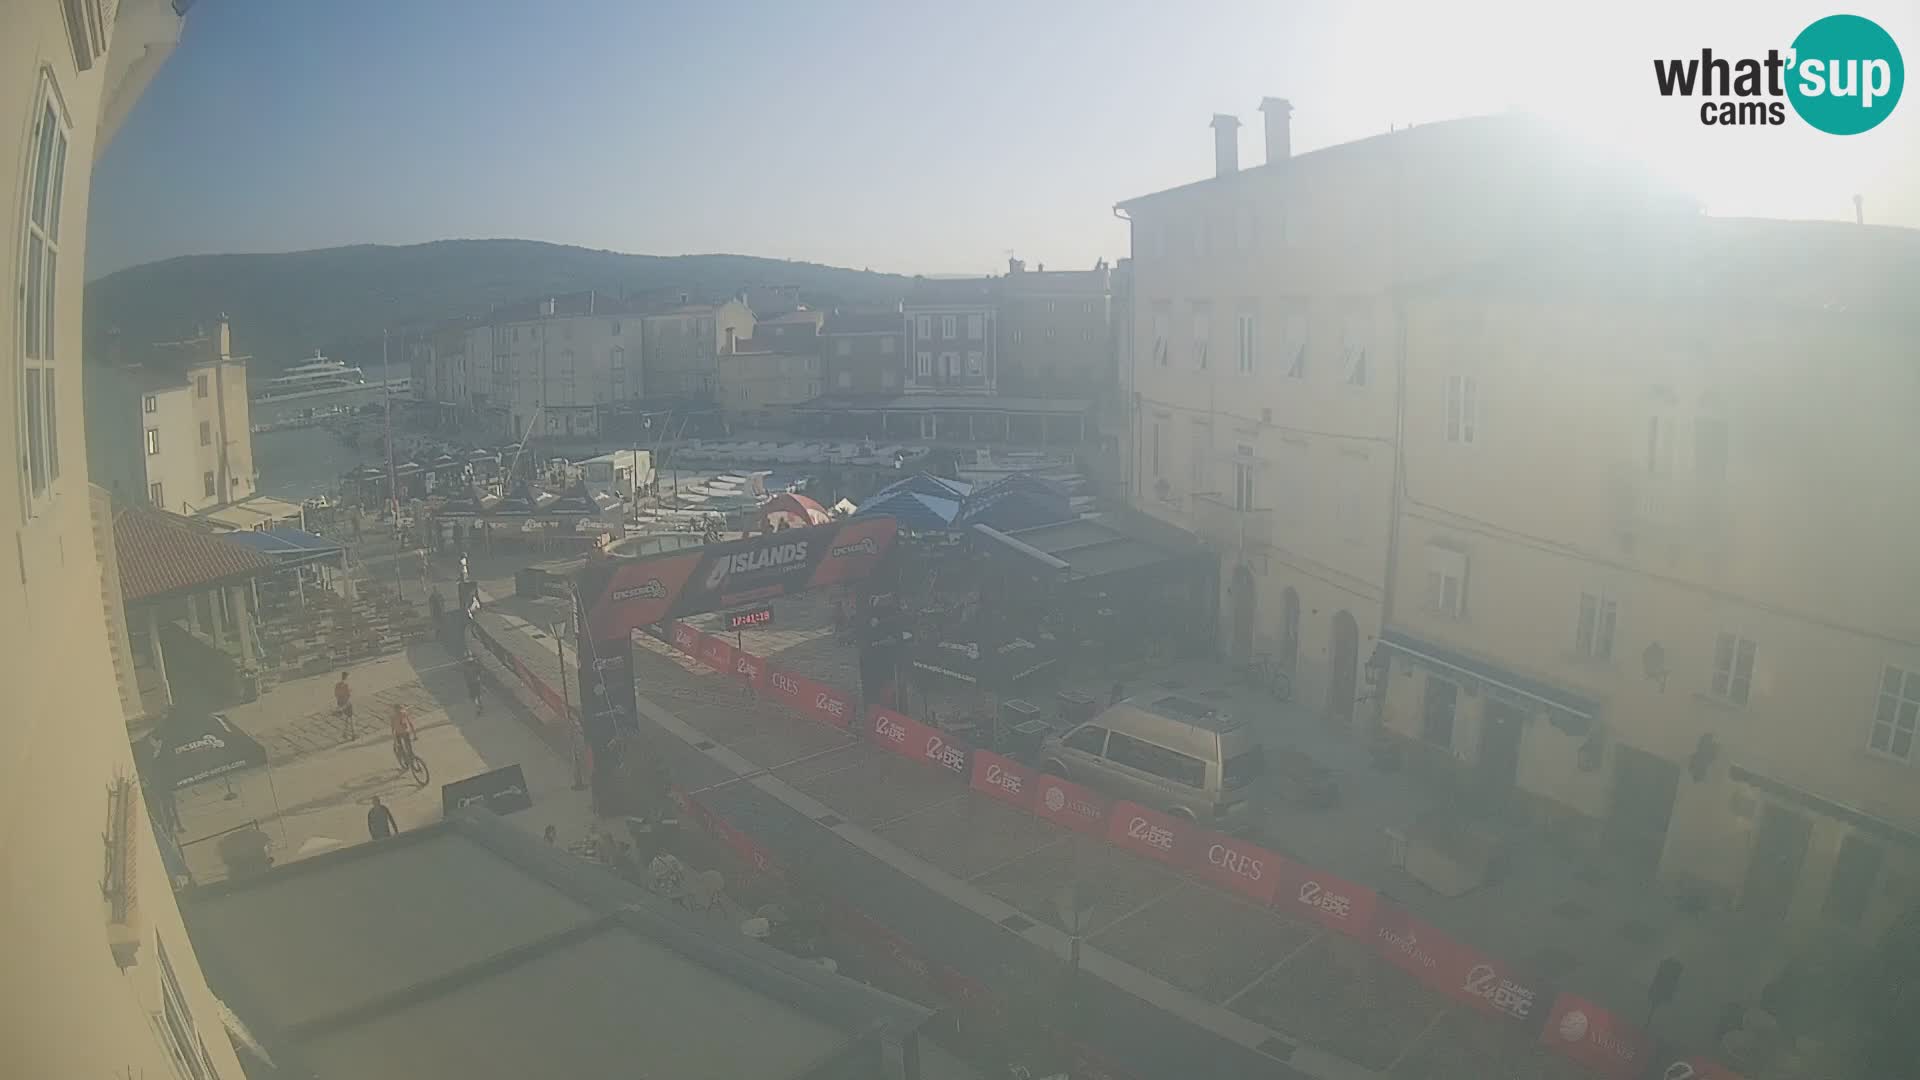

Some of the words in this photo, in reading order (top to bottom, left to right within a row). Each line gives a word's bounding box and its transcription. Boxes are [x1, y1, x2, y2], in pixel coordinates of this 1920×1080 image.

[729, 541, 808, 574] ISLANDS
[772, 672, 799, 696] CRES
[1208, 844, 1263, 880] CRES
